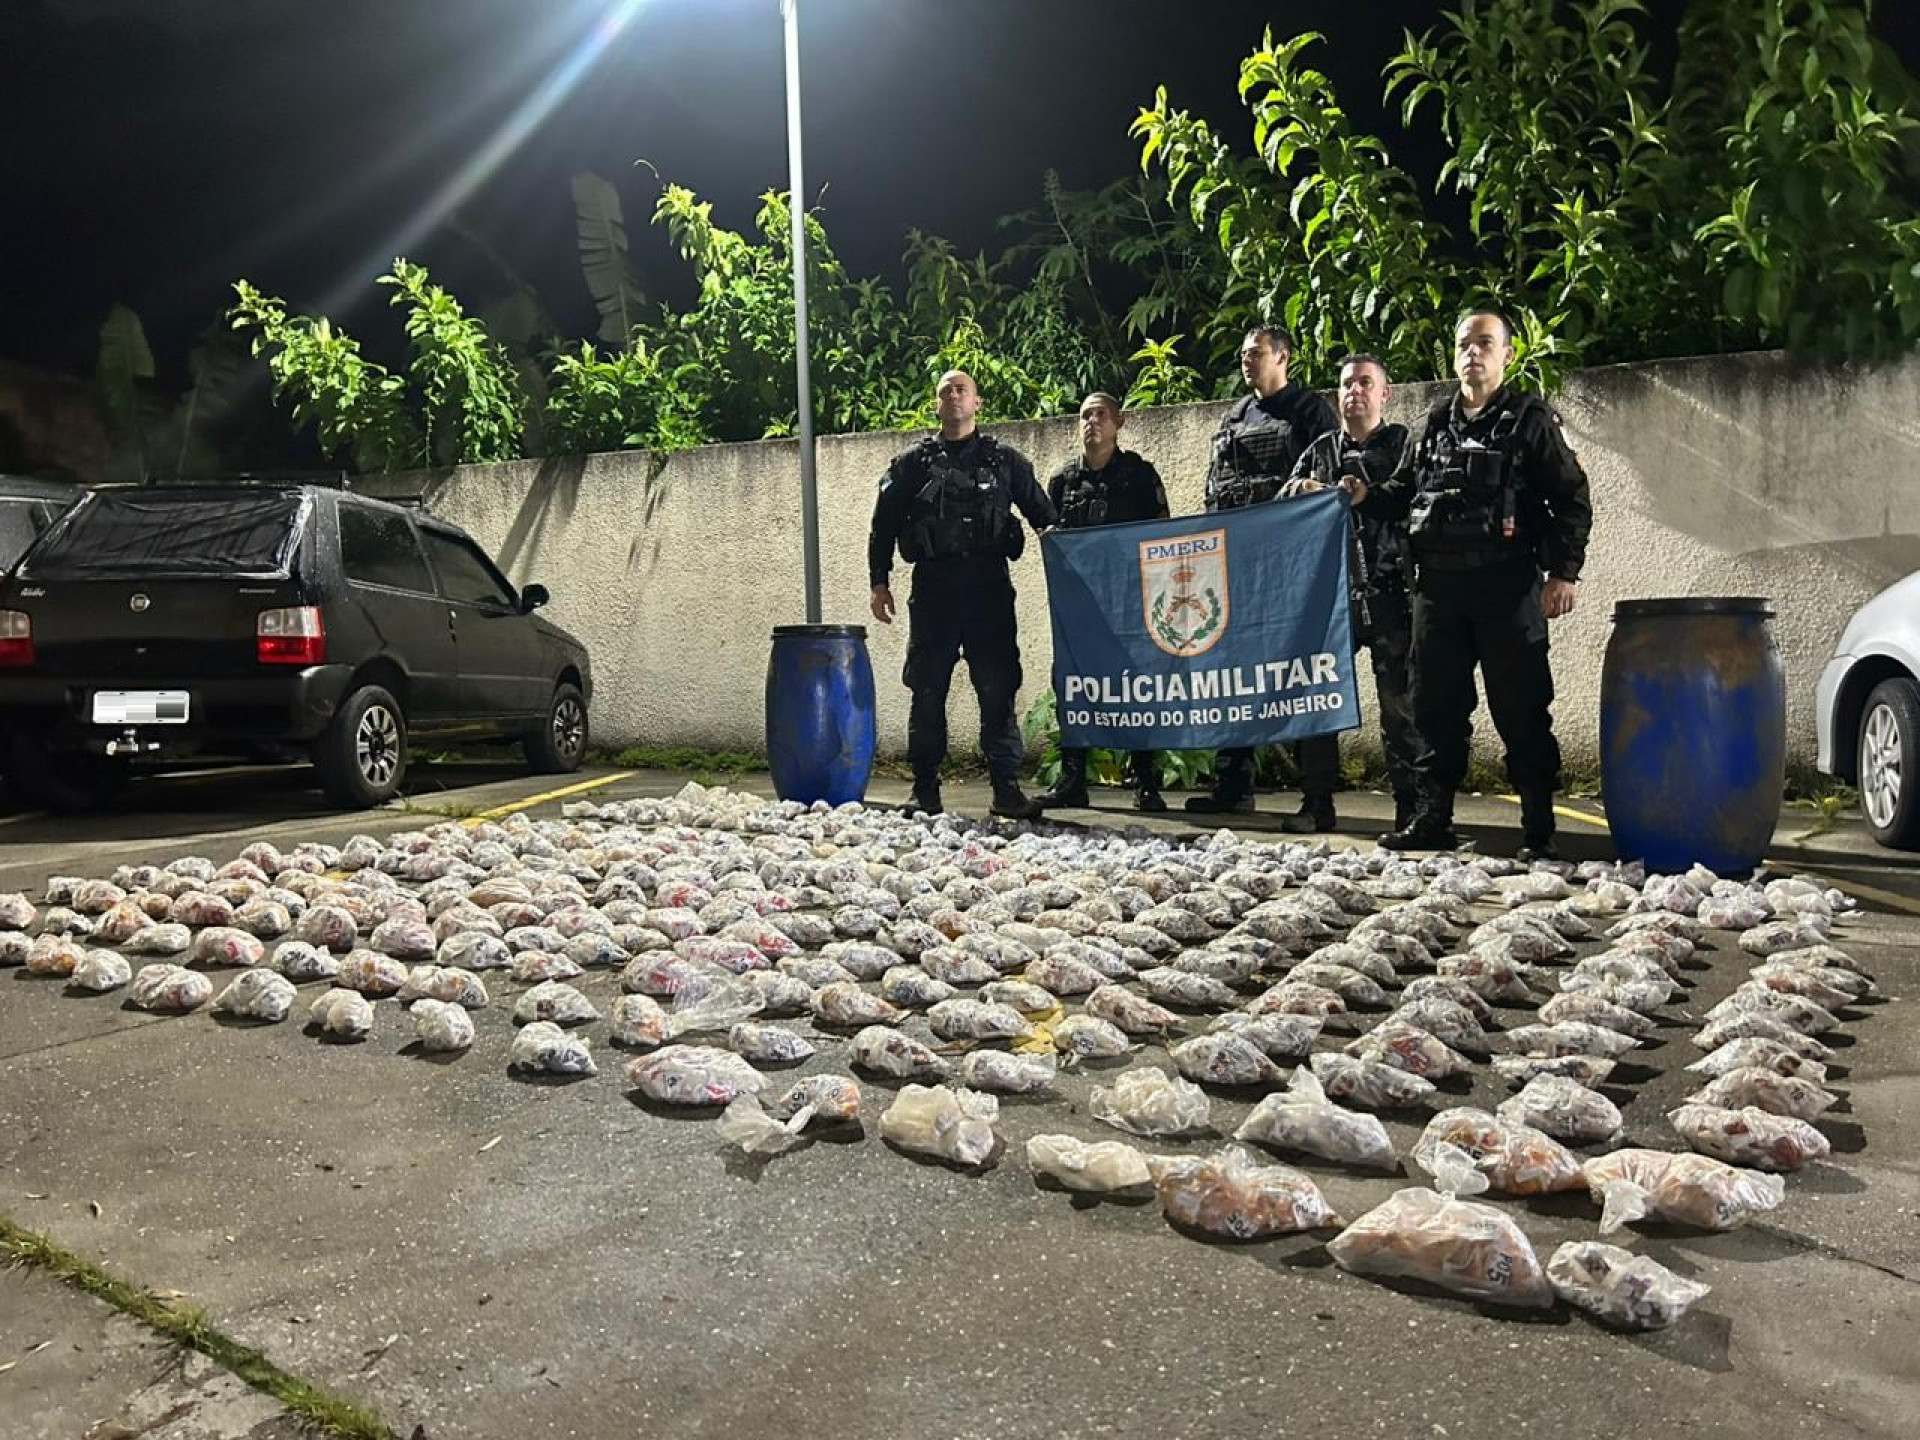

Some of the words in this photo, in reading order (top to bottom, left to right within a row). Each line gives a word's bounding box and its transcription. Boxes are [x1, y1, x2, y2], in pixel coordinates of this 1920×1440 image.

[1146, 537, 1218, 560] PMERJ
[1065, 669, 1191, 703] POLÍCIA
[1191, 652, 1339, 699] MILITAR
[1067, 710, 1090, 725] DO
[1094, 711, 1155, 727] ESTADO
[1160, 710, 1184, 726] DO
[1190, 706, 1222, 724] RIO
[1228, 704, 1252, 722] DE
[1258, 692, 1343, 720] JANEIRO
